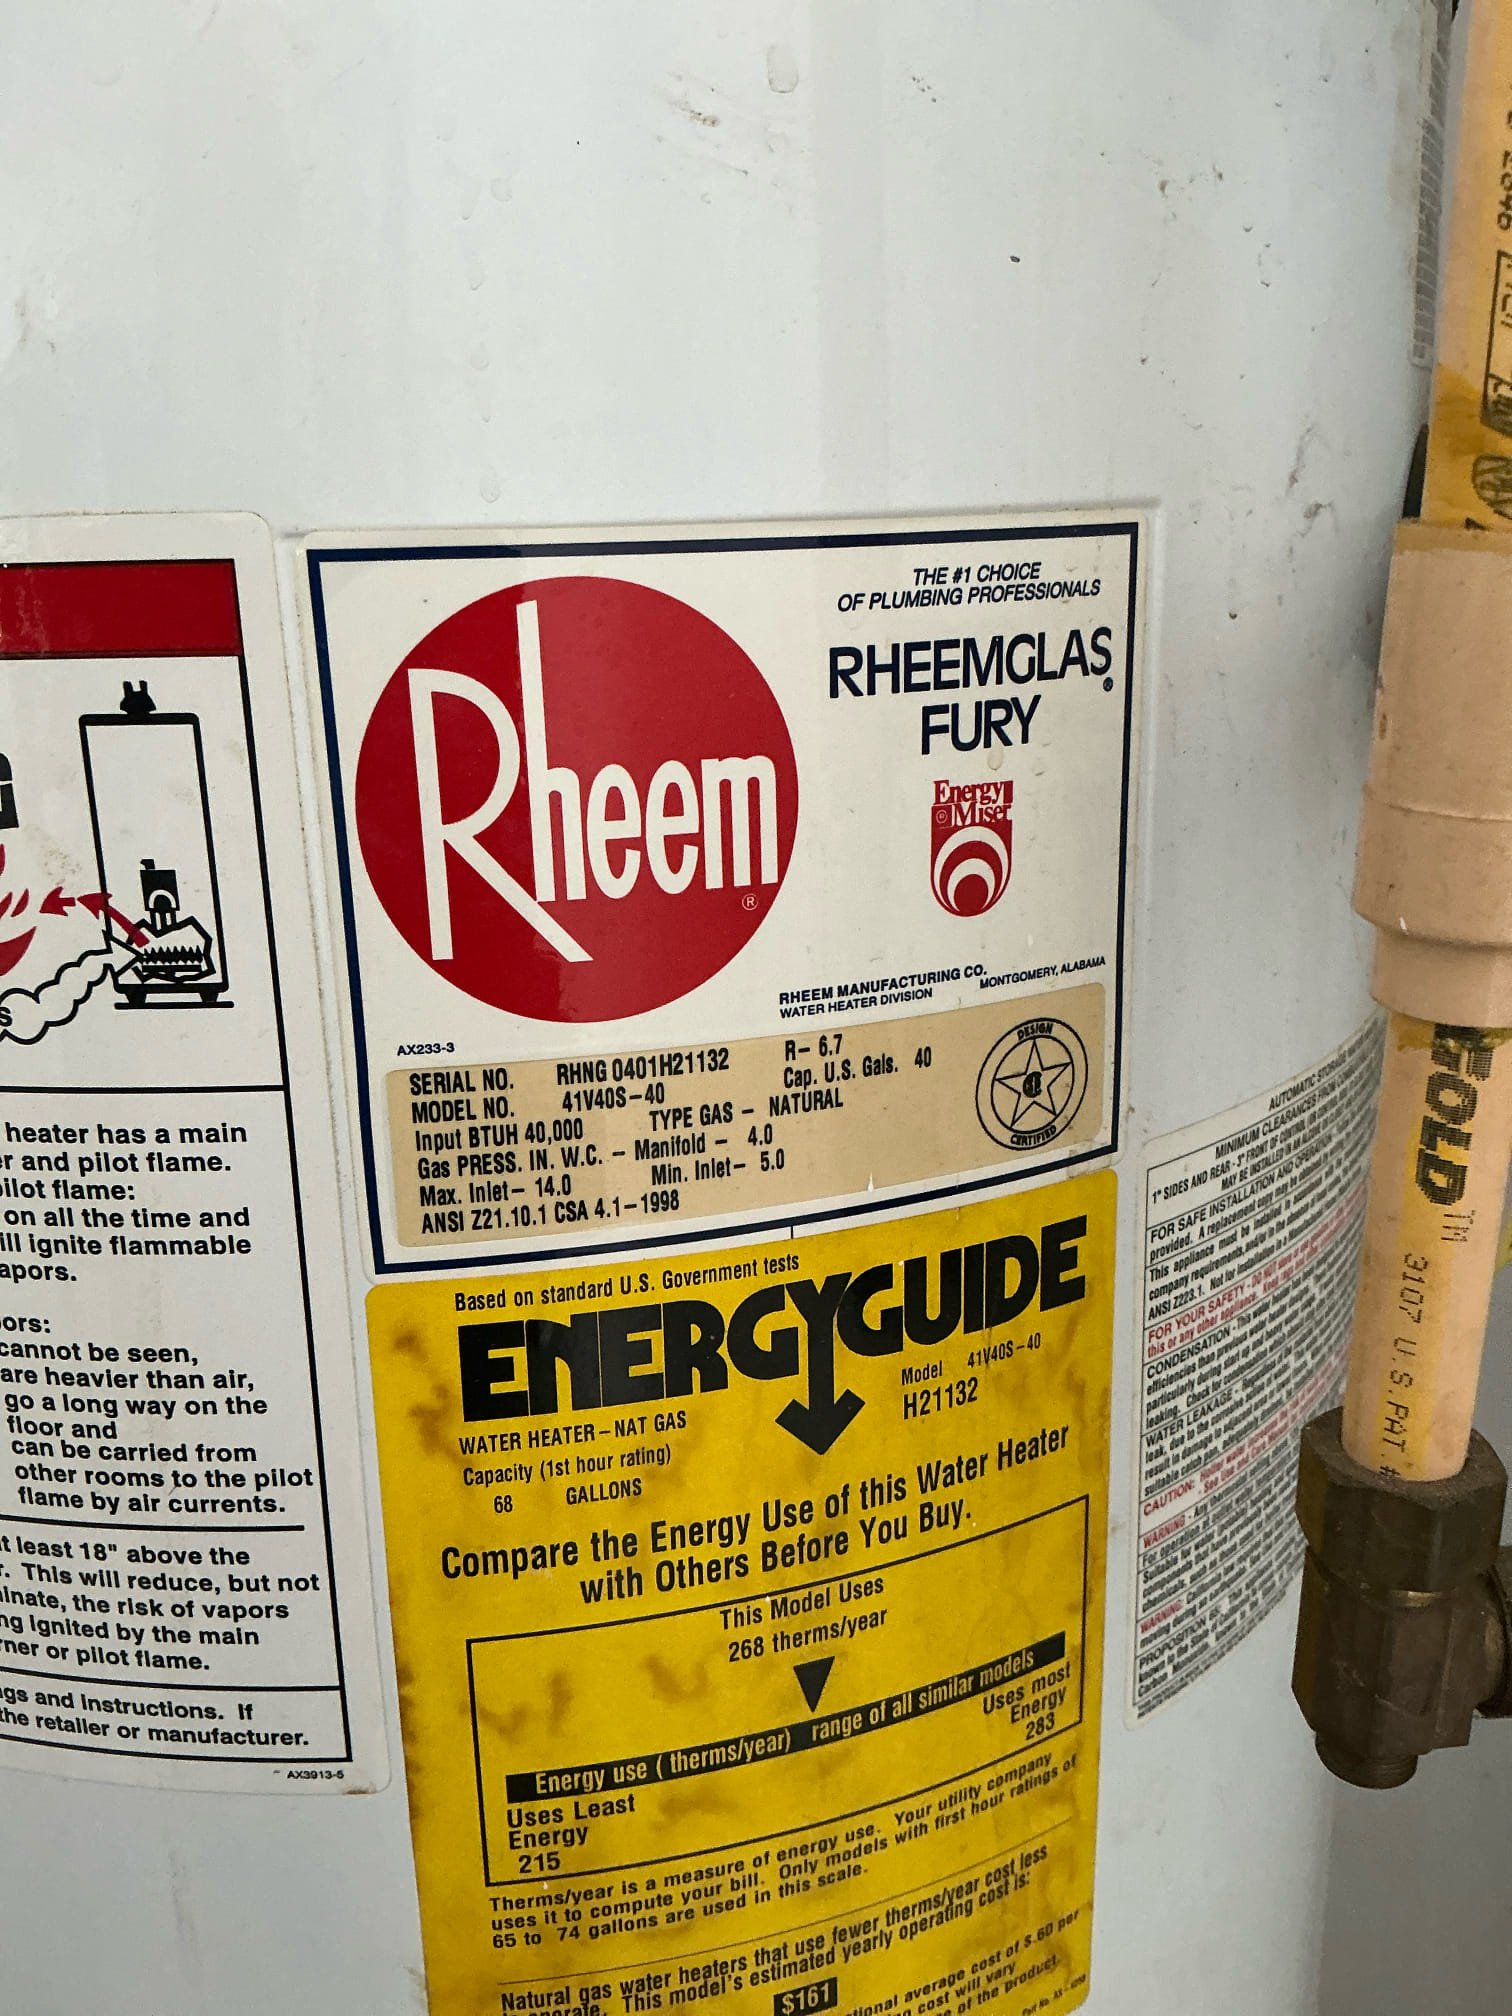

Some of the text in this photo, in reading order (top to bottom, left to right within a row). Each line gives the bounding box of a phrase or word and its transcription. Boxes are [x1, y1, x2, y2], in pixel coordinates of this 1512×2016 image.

[913, 562, 1041, 586] THE #1 CHOICE
[838, 579, 1101, 612] OF PLUMBING PROFESSIONALS
[829, 626, 1112, 699] RHEEMGLAS
[921, 694, 1041, 755] FURY
[407, 599, 778, 962] Rheem
[933, 779, 1005, 805] Energy
[952, 801, 1011, 826] Miser
[779, 964, 987, 1005] RHEEM MANUFACTURING CO.
[979, 956, 1106, 989] MONTGOMERY, ALABAMA
[780, 988, 932, 1019] WATER HEATER DIVISION
[397, 1042, 454, 1056] AX233-3
[818, 1034, 843, 1056] 6.7
[1017, 1023, 1053, 1040] DESIGN
[409, 1048, 729, 1096] SERIAL NO. RHNG 0401H21132
[784, 1046, 932, 1089] Cap. U.S. Gals. 40
[412, 1099, 477, 1124] MODEL
[483, 1096, 514, 1119] NO.
[649, 1088, 843, 1131] TYPE GAS NATURAL
[6, 1121, 247, 1144] heater has a main
[416, 1118, 583, 1152] Input BTUH 40,000
[1215, 1128, 1260, 1159] MINIMUM
[418, 1123, 772, 1180] Gas PRESS. IN. W.C. Manifold 4.0
[651, 1162, 688, 1186] Min.
[760, 1148, 785, 1172] 5.0
[420, 1184, 462, 1207] Max.
[535, 1174, 571, 1198] 14.0
[1163, 1179, 1188, 1200] SIDES
[1191, 1168, 1208, 1188] AND
[1210, 1162, 1230, 1180] REAR
[422, 1210, 464, 1234] ANSI
[471, 1205, 546, 1231] Z21.10.1
[554, 1200, 588, 1224] CSA
[1150, 1222, 1175, 1243] FOR
[1178, 1209, 1206, 1232] SAFE
[1209, 1172, 1275, 1217] INSTALLATION
[455, 1254, 799, 1312] Based on standard U.S. Government tests
[458, 1215, 1087, 1425] ENERGYGUIDE
[1149, 1283, 1244, 1343] FOR YOUR SAFETY
[1147, 1327, 1230, 1378] CONDENSATION
[901, 1360, 943, 1386] Model
[904, 1377, 978, 1420] H21132
[459, 1411, 687, 1455] WATER HEATER NAT GAS
[1146, 1389, 1233, 1447] WATER LEAKAGE
[12, 1439, 257, 1462] can be carried from
[463, 1444, 671, 1487] Capacity (1st hour rating)
[16, 1465, 312, 1490] other rooms to the pilot
[494, 1478, 642, 1514] 68 GALLONS
[441, 1425, 1068, 1579] Compare the Energy Use of this Water Heater
[17, 1536, 250, 1564] least 18" above the
[580, 1498, 971, 1604] with Others Before You Buy.
[720, 1577, 884, 1630] This Model Uses
[728, 1608, 887, 1662] 268 therms/year
[983, 1663, 1071, 1715] Uses most
[1011, 1687, 1067, 1724] Energy
[536, 1768, 605, 1794] Energy
[614, 1762, 648, 1784] use
[811, 1714, 862, 1743] range
[869, 1705, 888, 1726] of
[893, 1696, 912, 1718] all
[919, 1679, 973, 1709] similar
[980, 1650, 1034, 1687] models
[1026, 1714, 1055, 1741] 283
[507, 1794, 635, 1828] Uses Least
[489, 1752, 1052, 1912] Therms/year is a measure of energy use. Your utility company
[509, 1826, 588, 1850] Energy
[518, 1852, 560, 1874] 215
[781, 1983, 829, 2014] $161
